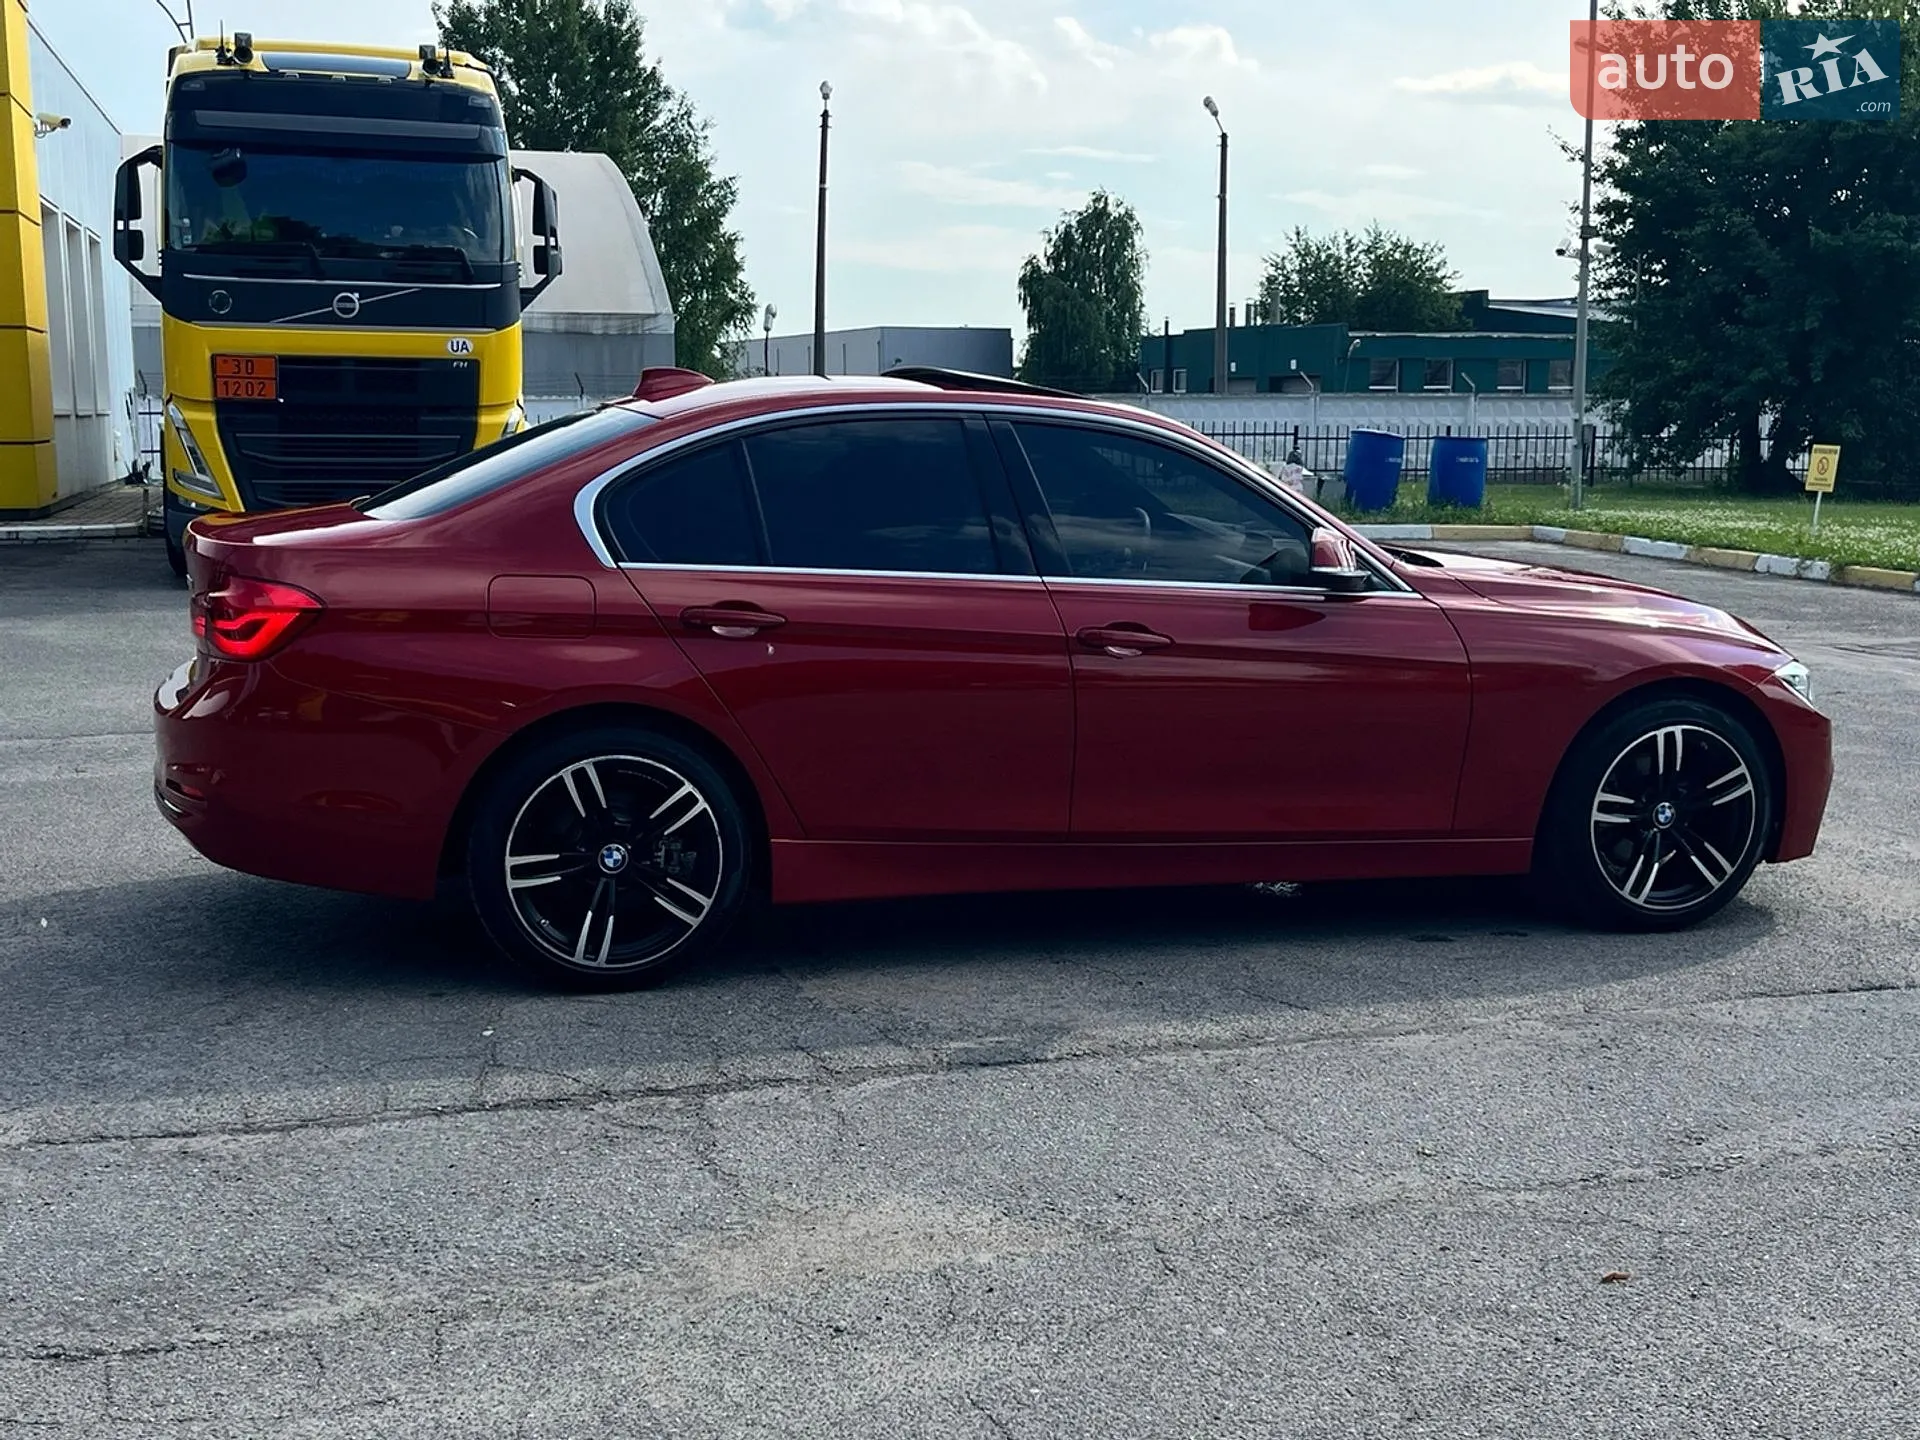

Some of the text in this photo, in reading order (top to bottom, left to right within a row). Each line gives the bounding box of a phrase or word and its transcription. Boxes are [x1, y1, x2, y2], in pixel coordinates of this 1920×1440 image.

[450, 340, 470, 353] UA
[231, 358, 254, 375] 30
[222, 381, 266, 397] 1202
